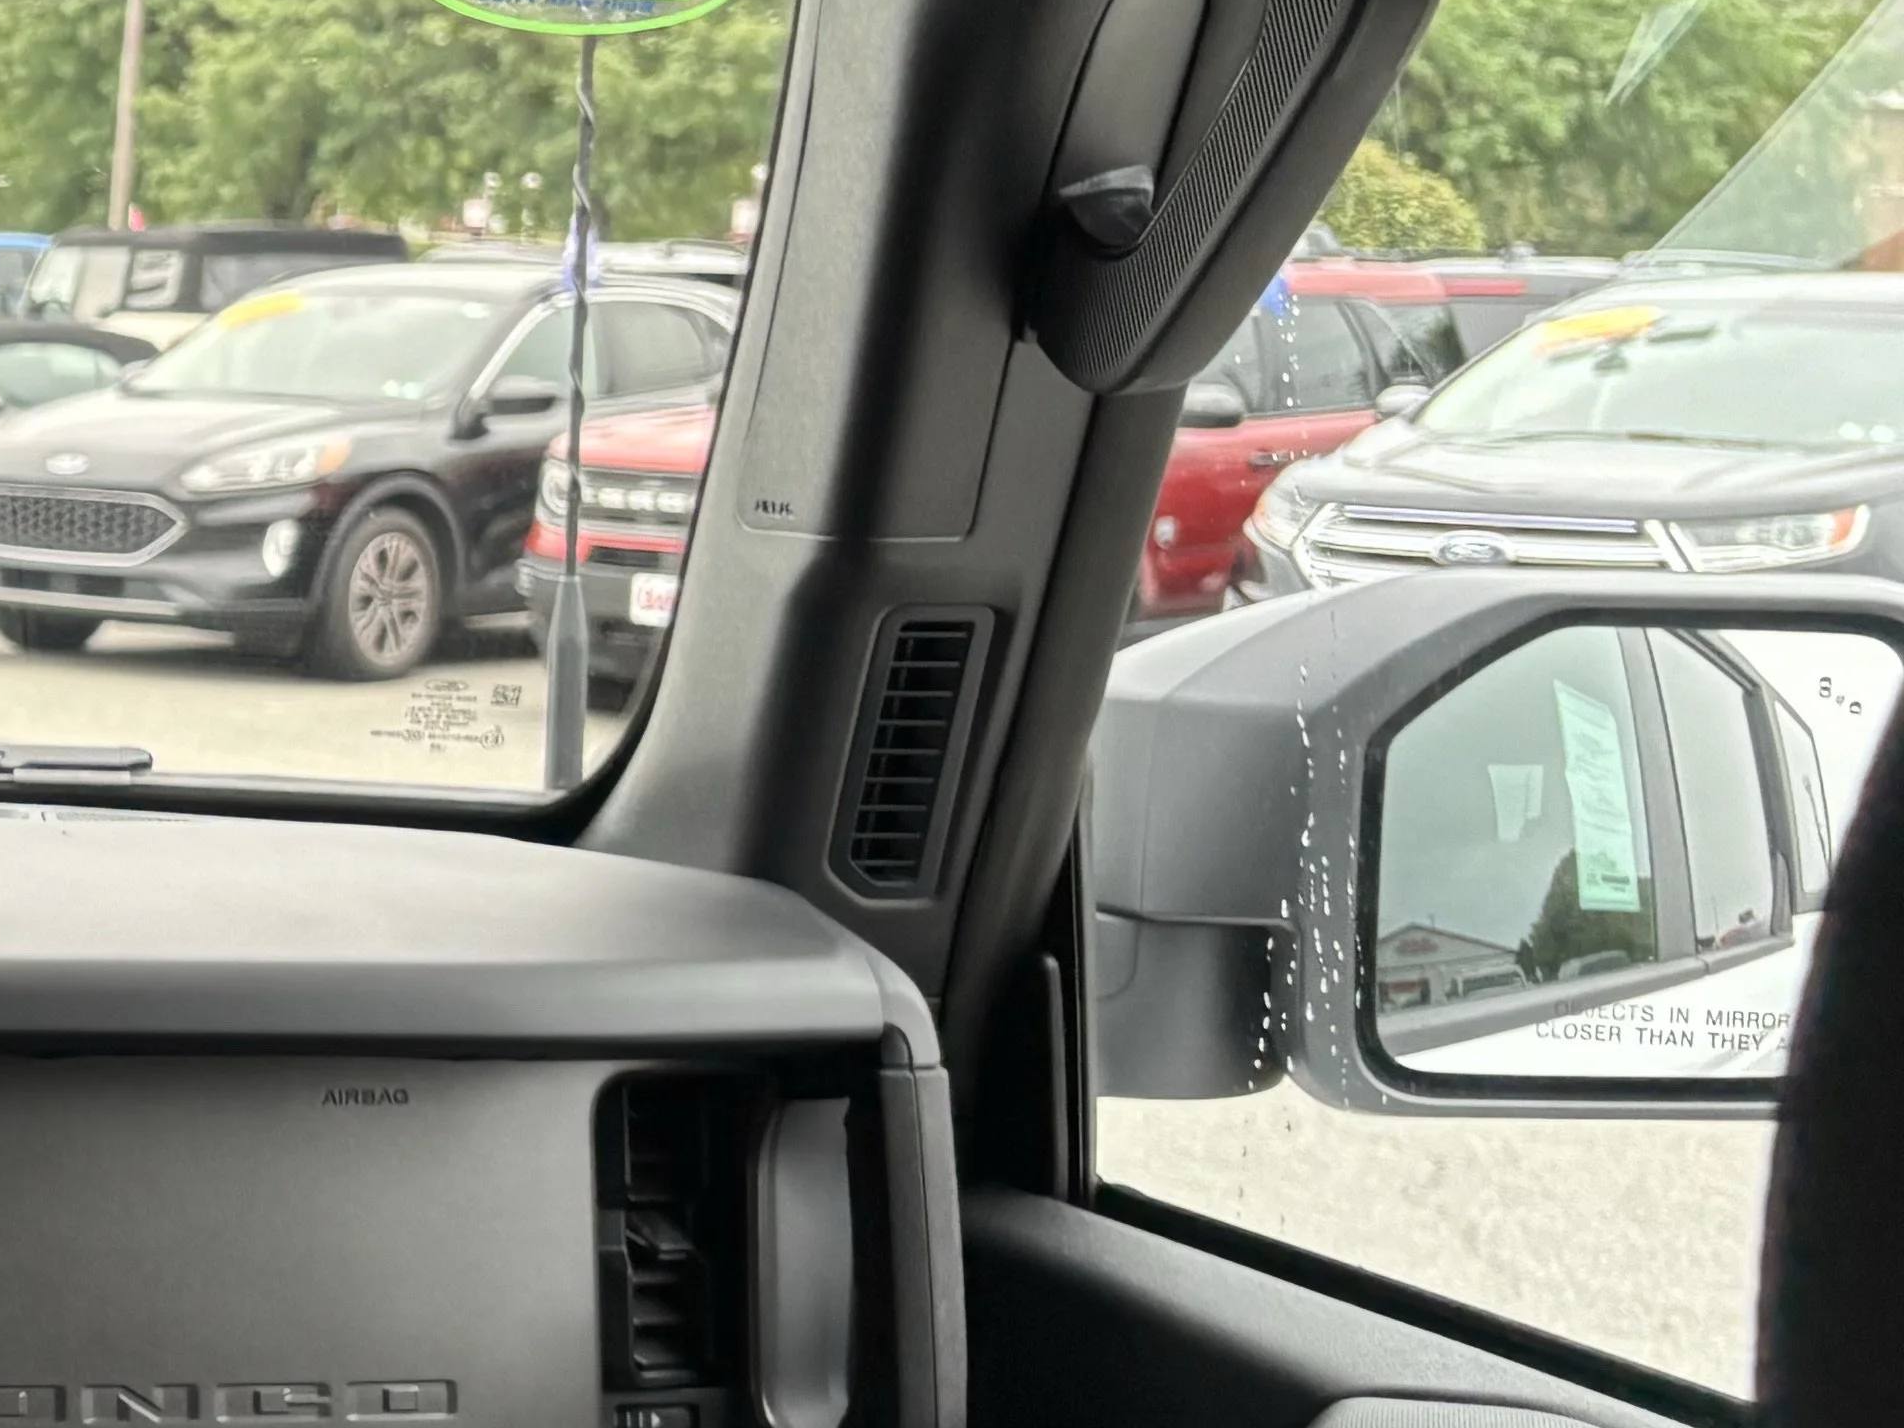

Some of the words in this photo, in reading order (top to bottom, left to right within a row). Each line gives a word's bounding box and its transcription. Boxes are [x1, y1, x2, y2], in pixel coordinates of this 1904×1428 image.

[1670, 1006, 1690, 1025] IN
[1536, 1022, 1622, 1044] CLOSER
[1635, 1027, 1694, 1048] THAN
[1710, 1031, 1764, 1052] THEY
[320, 1087, 410, 1107] AIRBAG
